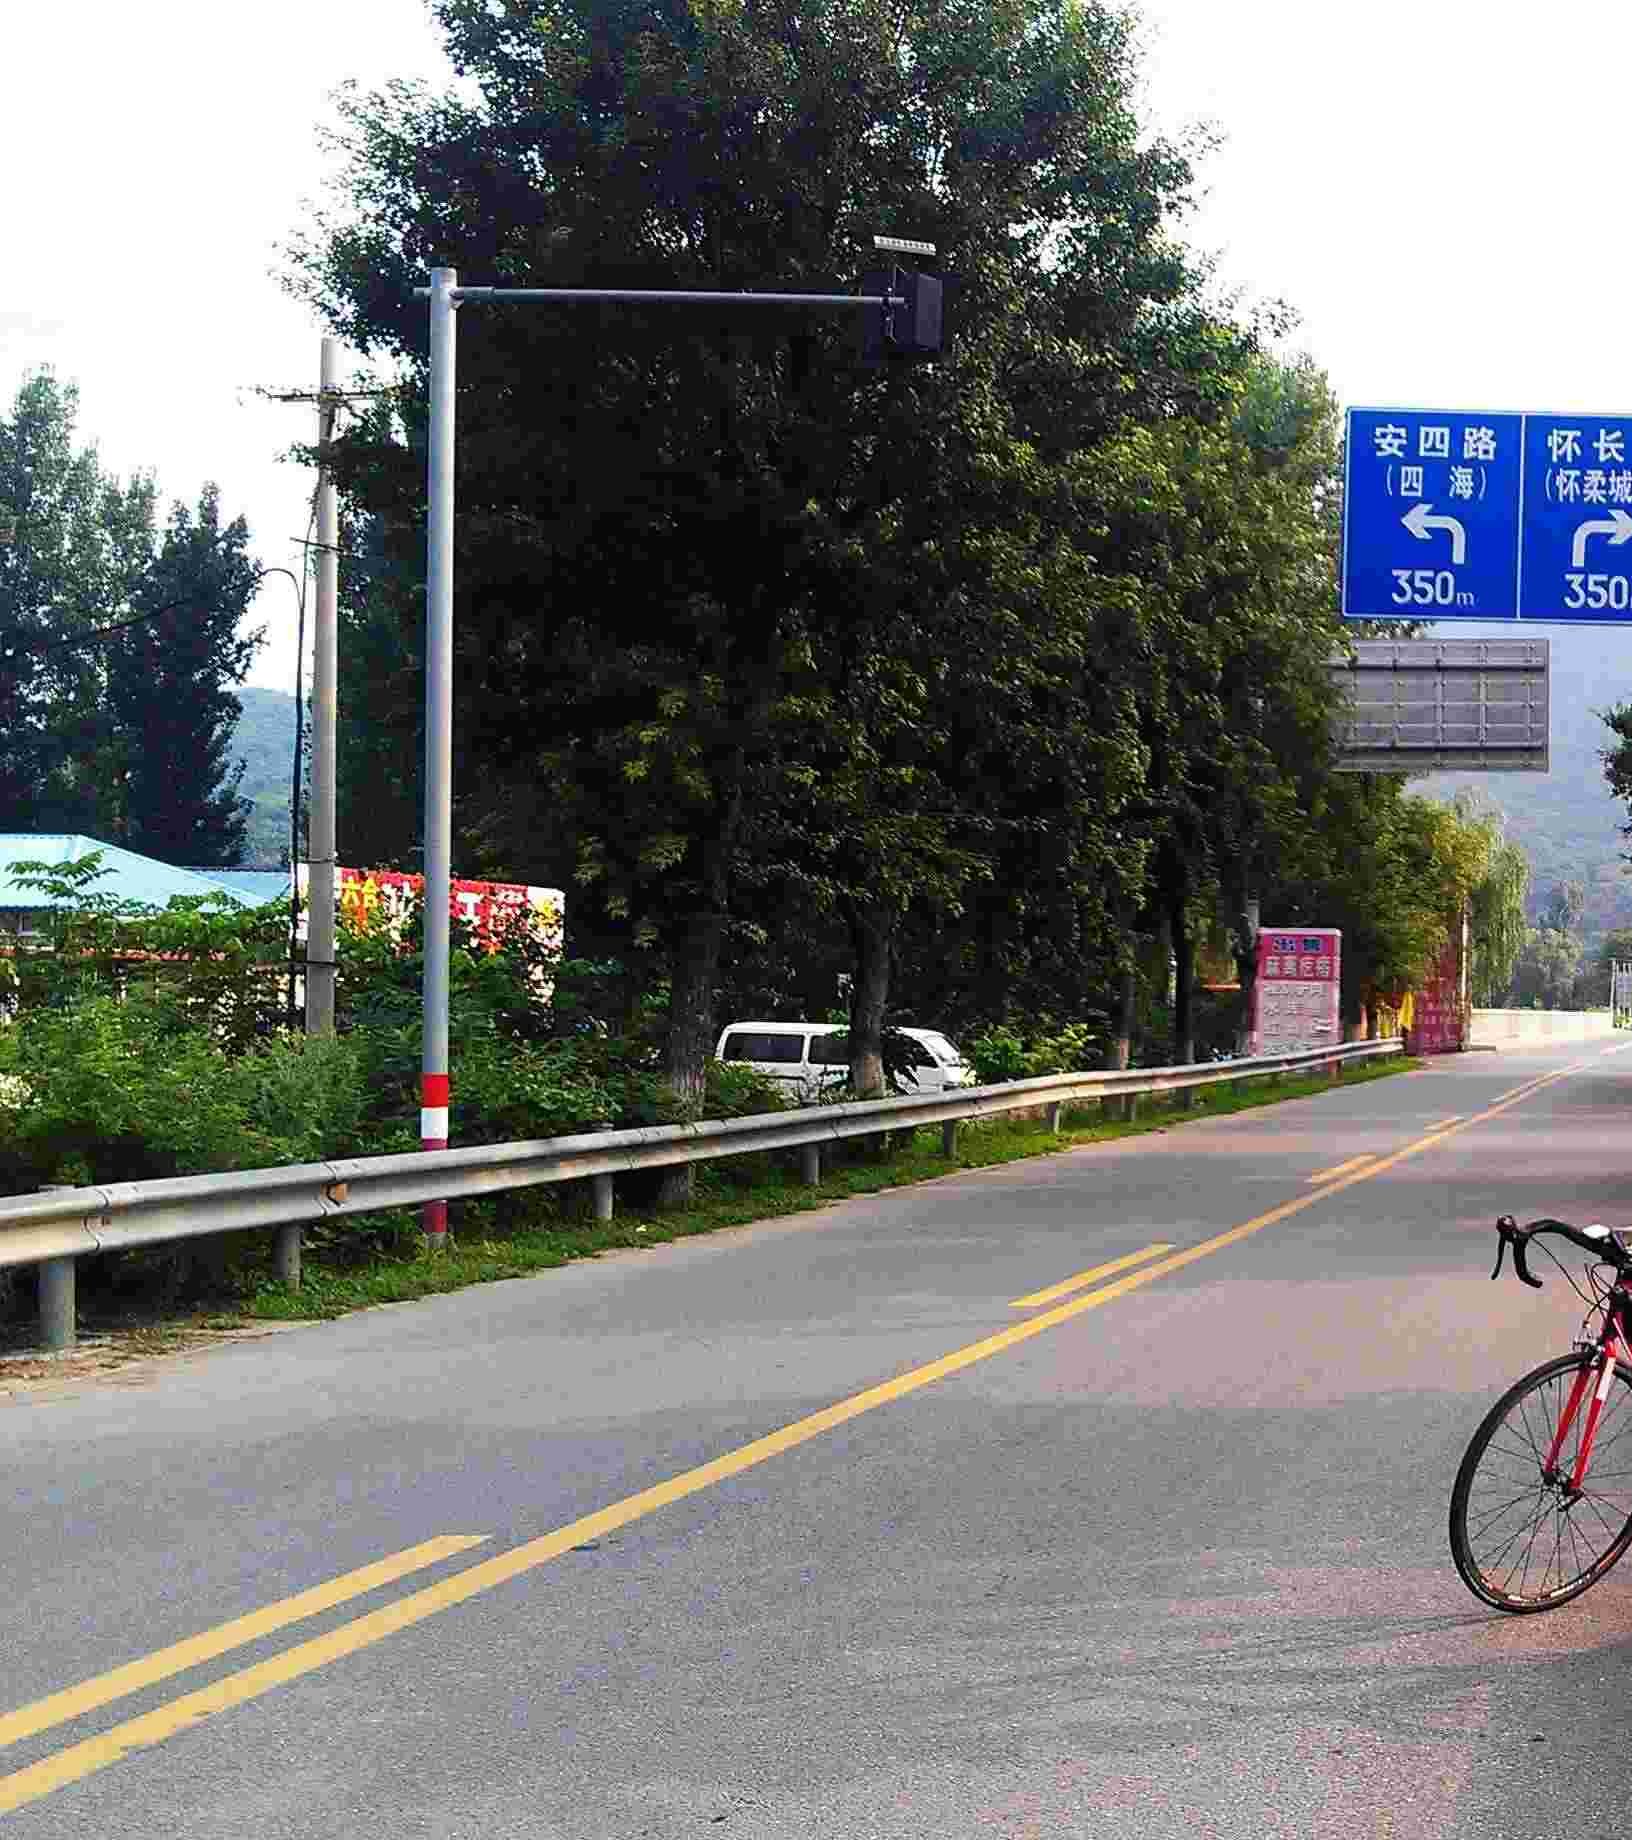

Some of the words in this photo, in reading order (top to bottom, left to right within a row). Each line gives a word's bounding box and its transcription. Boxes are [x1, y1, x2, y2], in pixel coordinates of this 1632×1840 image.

[1374, 424, 1497, 461] 安四路
[1391, 569, 1475, 607] 350m
